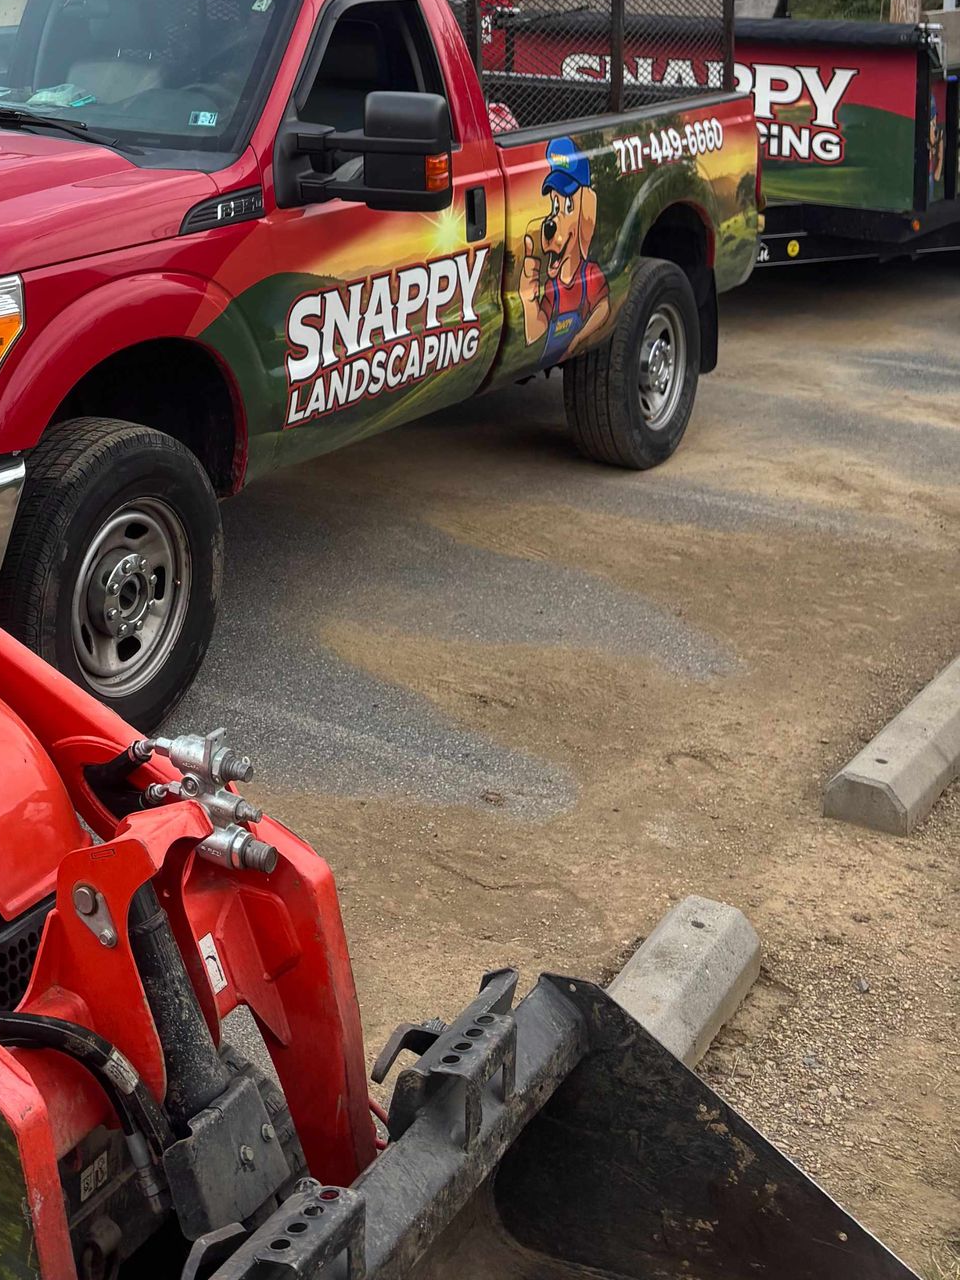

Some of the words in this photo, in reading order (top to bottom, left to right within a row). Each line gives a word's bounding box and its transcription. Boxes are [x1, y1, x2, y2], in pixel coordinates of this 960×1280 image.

[612, 117, 723, 173] 717-449-6660
[287, 246, 490, 385] SNAPPY
[286, 327, 481, 425] LANDSCAPING
